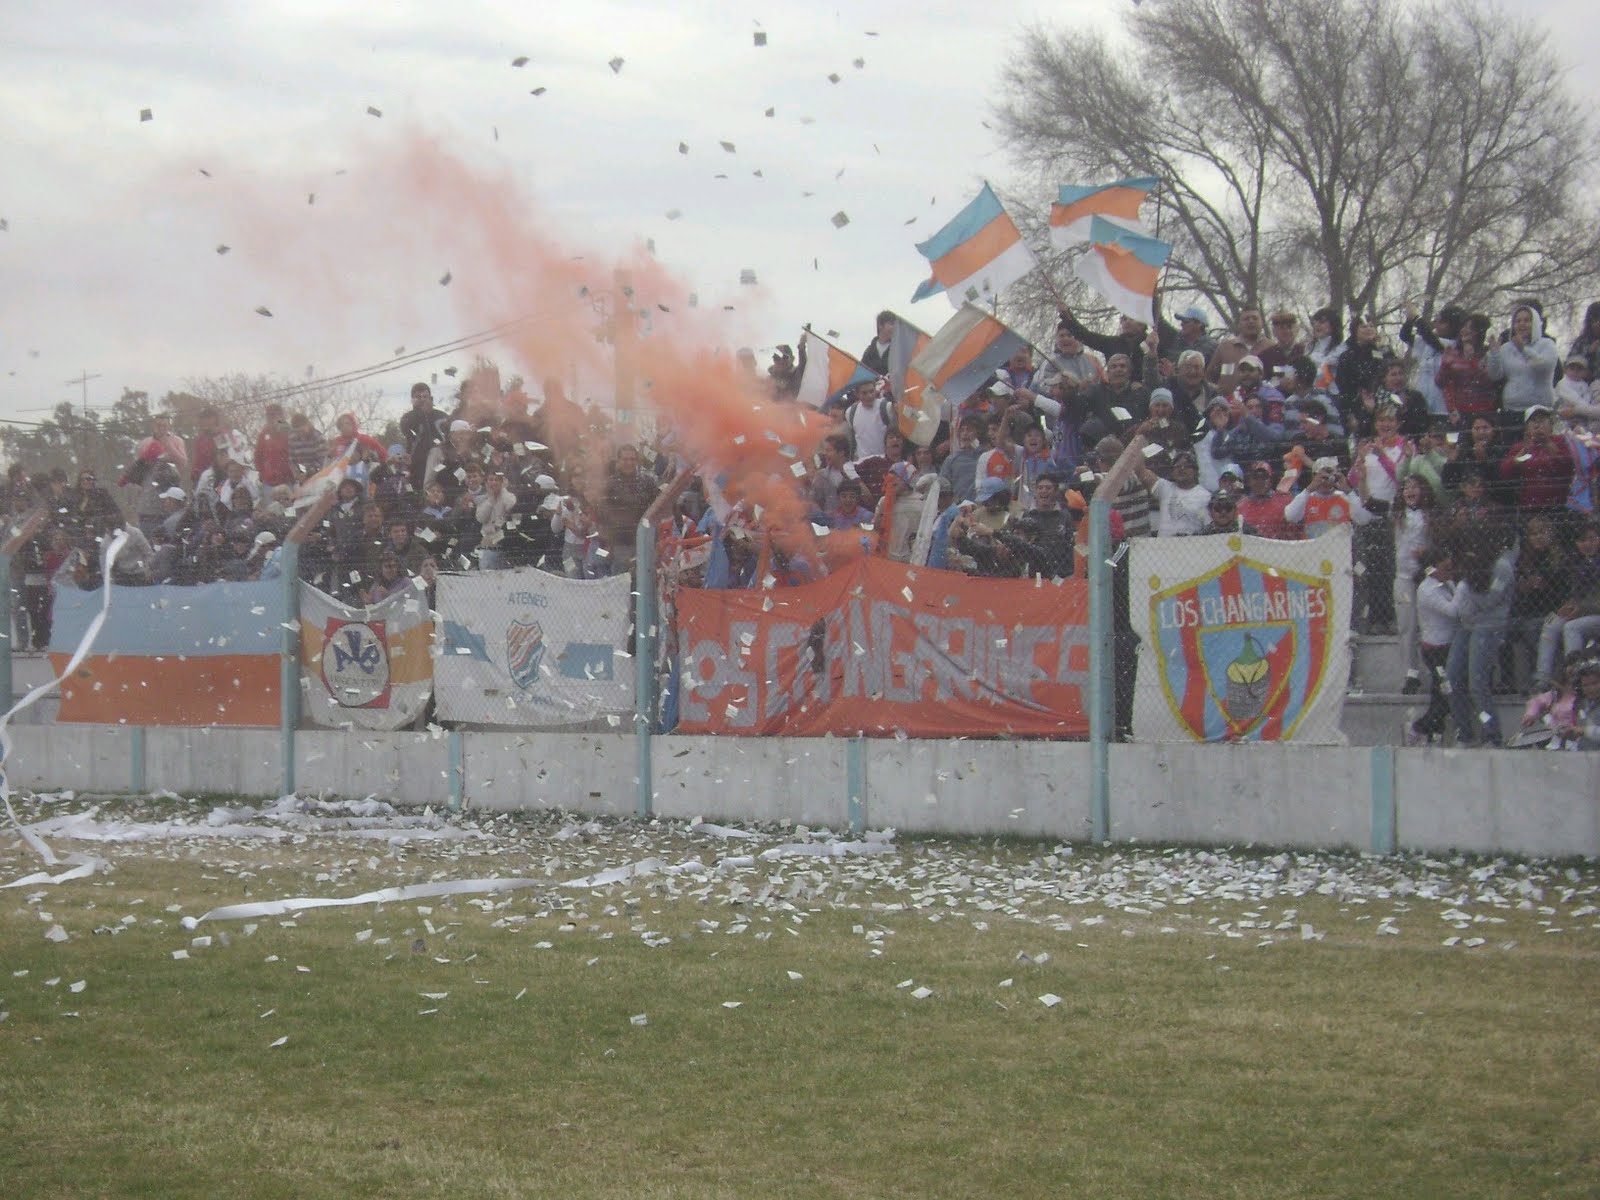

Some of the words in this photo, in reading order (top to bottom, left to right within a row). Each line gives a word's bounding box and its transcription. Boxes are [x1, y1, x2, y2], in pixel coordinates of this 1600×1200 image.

[507, 591, 549, 608] ATENEO
[1160, 599, 1199, 629] LOS
[1201, 588, 1327, 624] CHANGARINES
